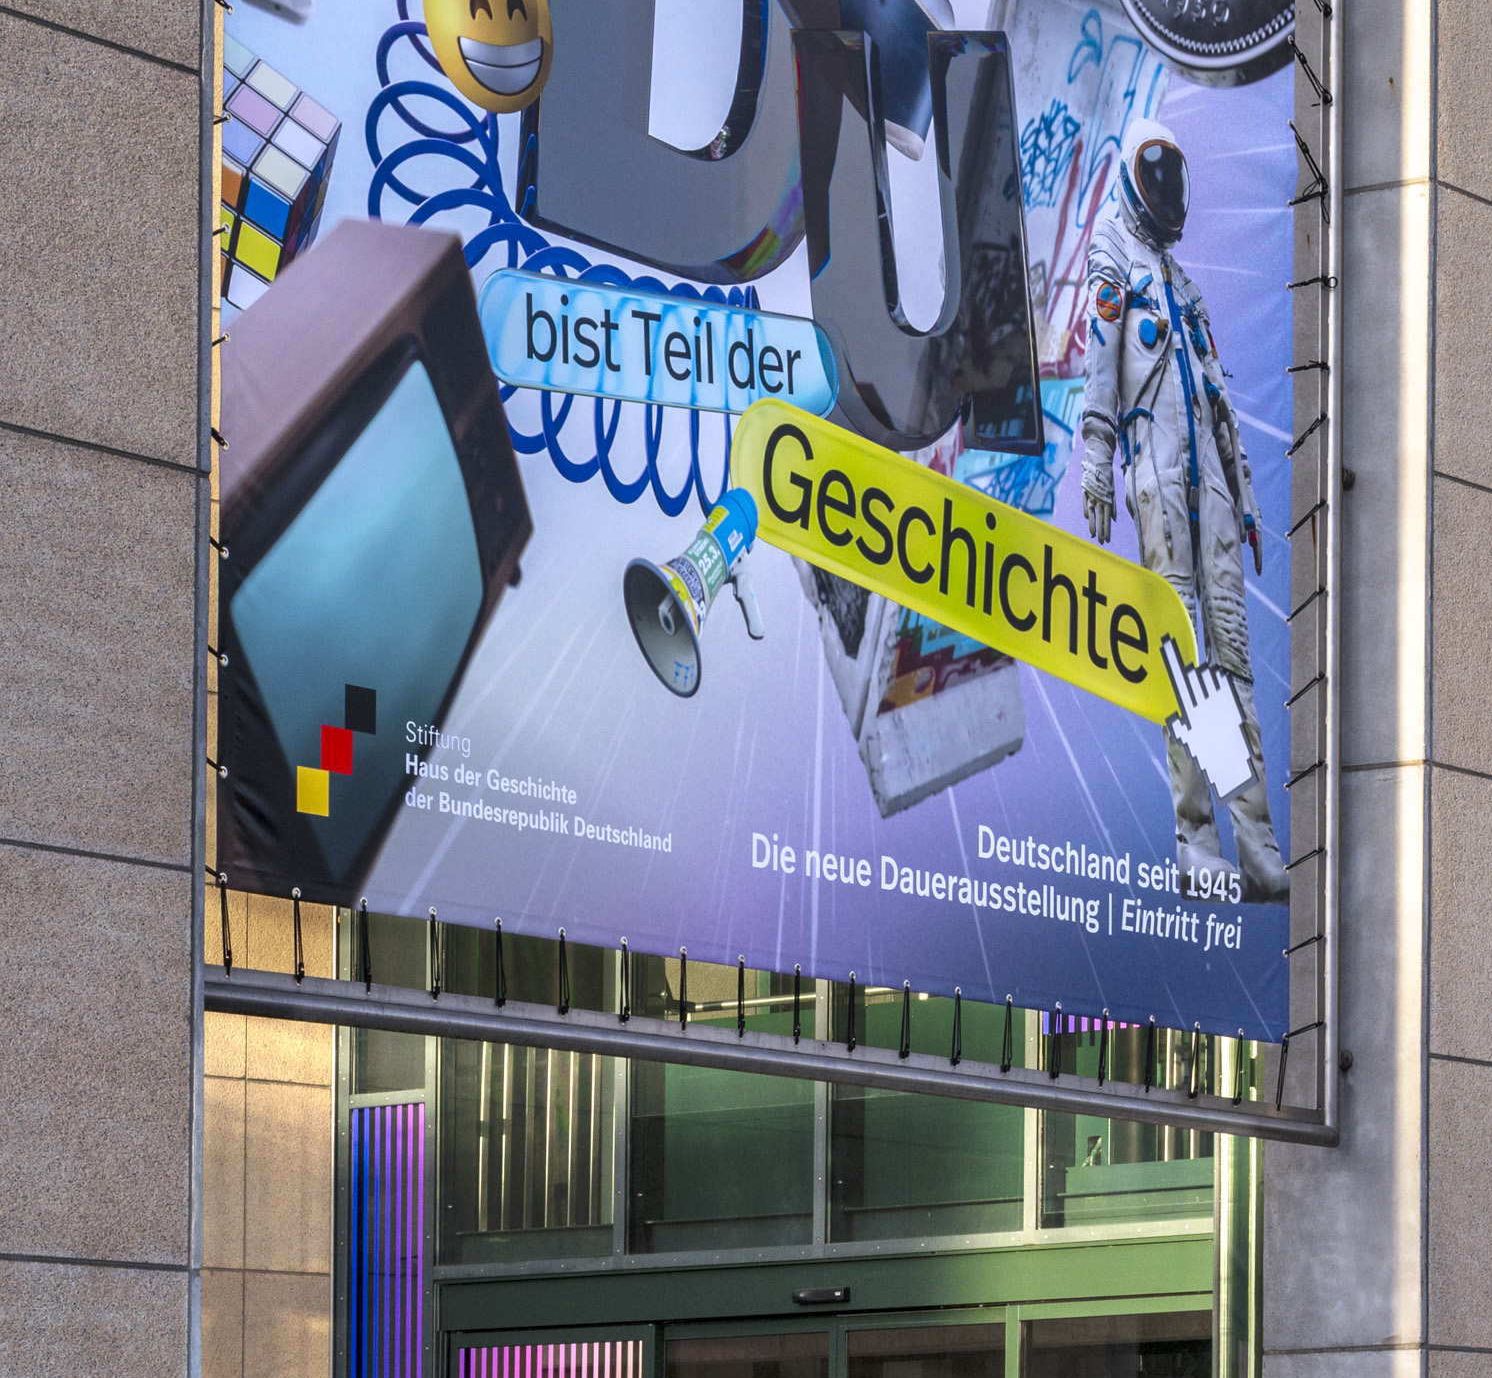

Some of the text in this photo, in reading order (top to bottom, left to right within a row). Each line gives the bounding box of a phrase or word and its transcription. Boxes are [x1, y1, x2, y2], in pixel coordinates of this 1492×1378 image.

[526, 292, 801, 395] bist Teil der
[762, 423, 1149, 684] Geschichte
[405, 720, 471, 758] Stiftung
[405, 753, 577, 805] Haus der Geschichte
[405, 786, 672, 853] der Bundesrepublik Deutschland
[752, 832, 796, 874] Die
[805, 849, 872, 887] neue
[881, 855, 1099, 933] Dauerausstellung
[1121, 898, 1199, 943] Eintritt
[1204, 913, 1242, 951] frei
[978, 825, 1242, 905] Deutschland seit 1945
